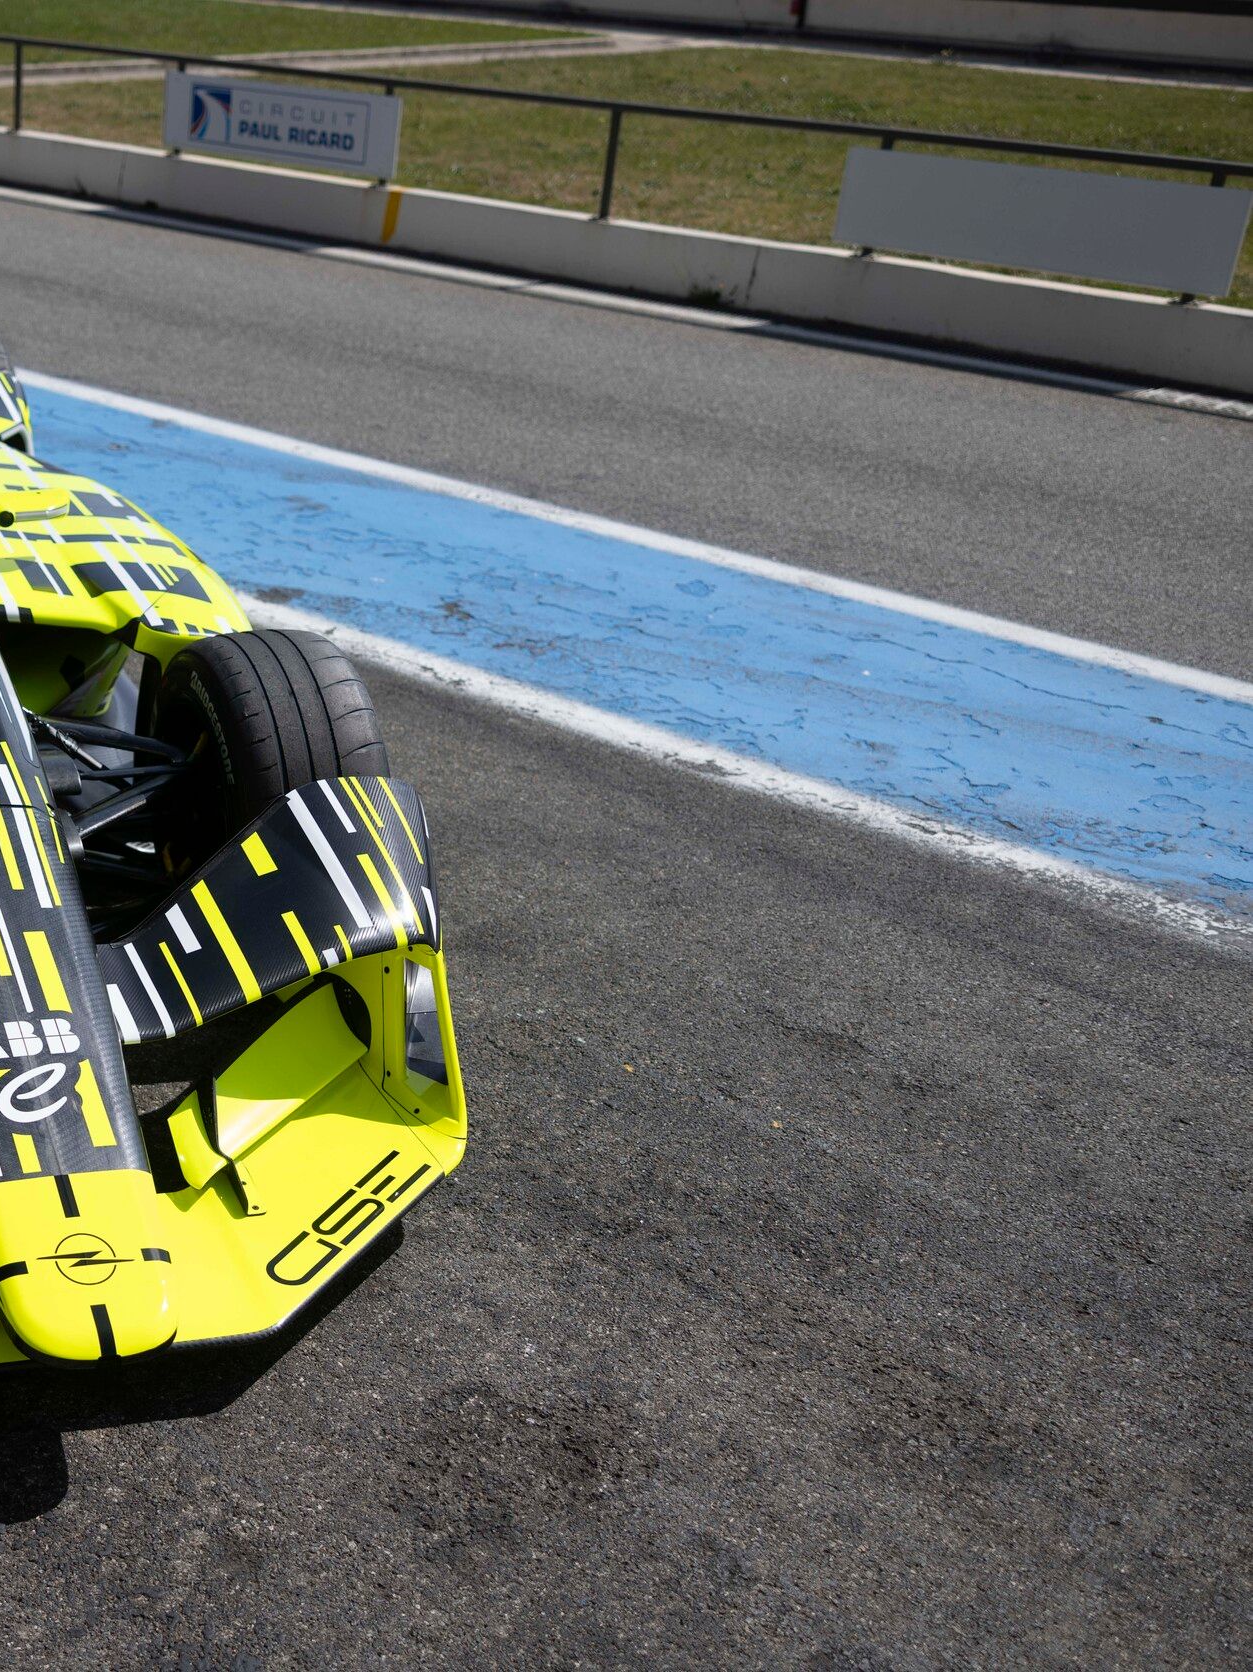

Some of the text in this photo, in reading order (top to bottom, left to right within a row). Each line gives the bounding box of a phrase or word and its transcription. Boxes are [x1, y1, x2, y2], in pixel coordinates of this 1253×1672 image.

[238, 101, 357, 126] CIRCUIT
[238, 120, 355, 151] PAUL RICARD
[265, 1149, 432, 1286] GSE
